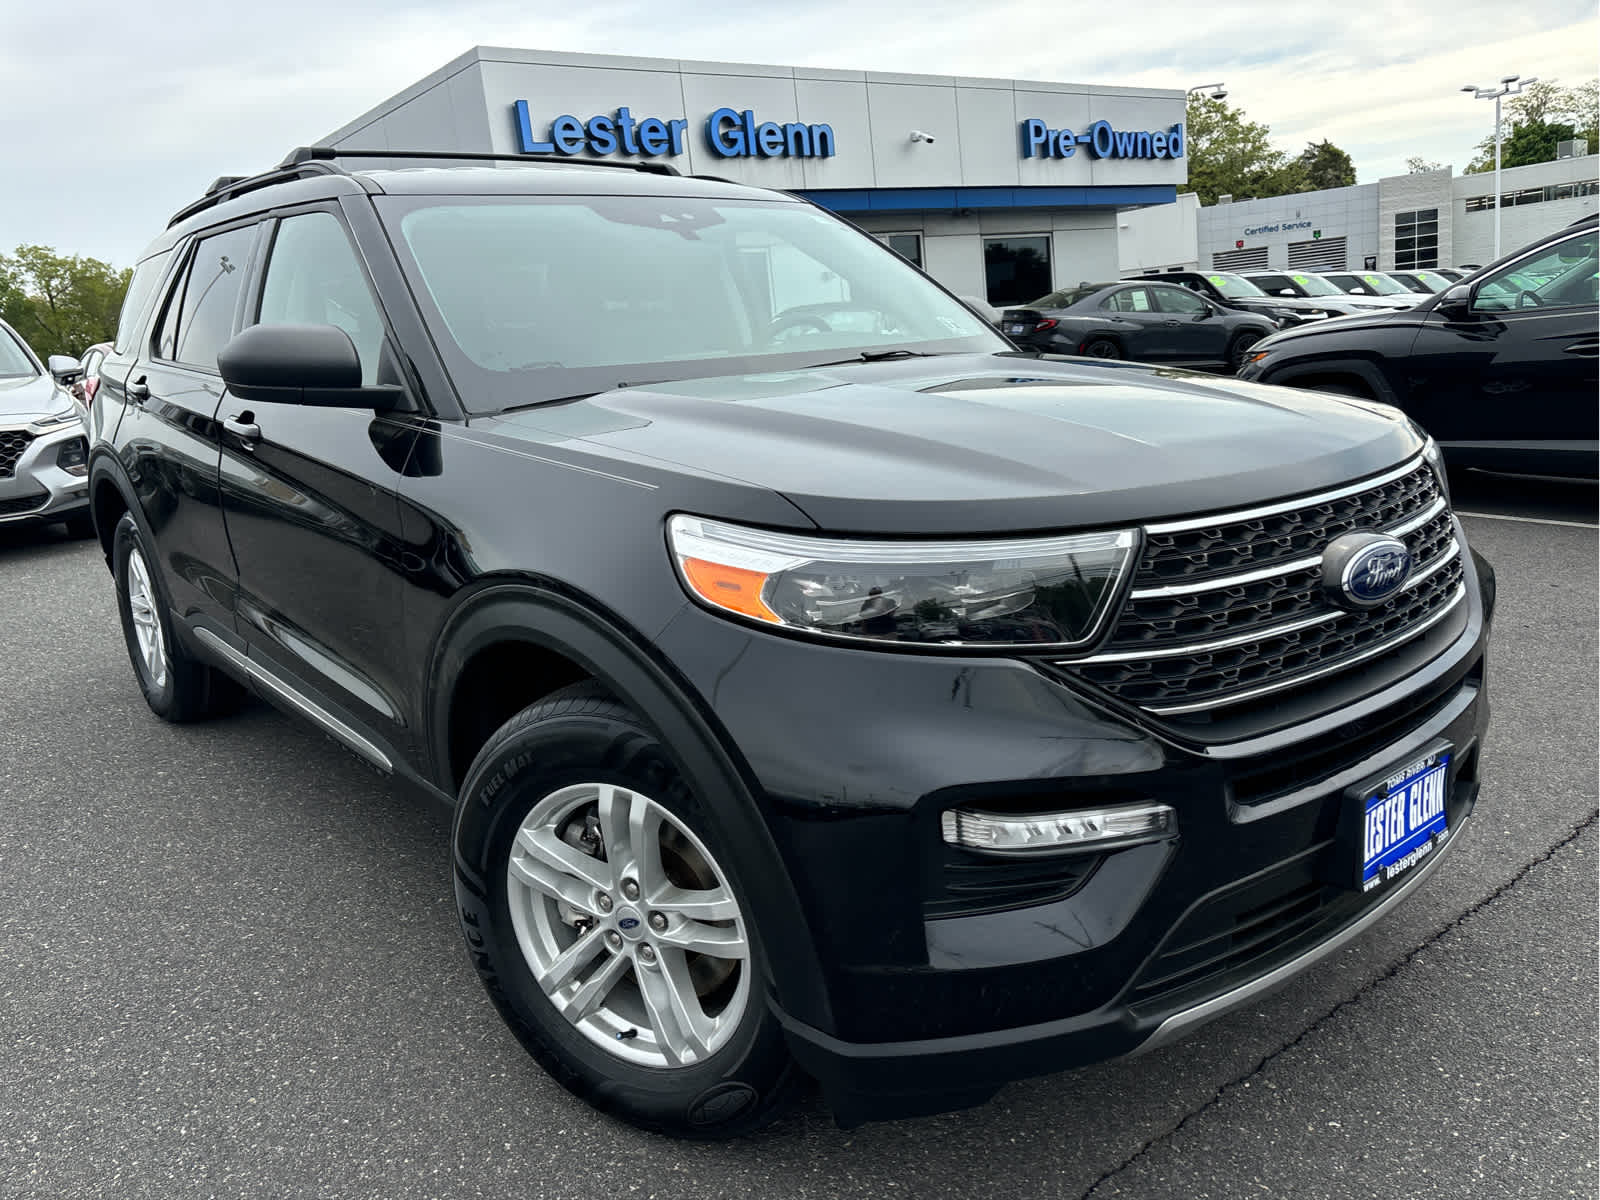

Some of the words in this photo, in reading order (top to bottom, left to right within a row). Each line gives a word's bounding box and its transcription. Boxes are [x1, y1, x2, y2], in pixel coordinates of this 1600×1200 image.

[512, 99, 688, 155] Lester
[704, 107, 836, 158] Glenn
[1023, 118, 1184, 159] Pre-Owned
[1244, 224, 1280, 236] Certified
[1282, 221, 1312, 231] Service
[1364, 791, 1407, 864] LESTER
[1409, 767, 1446, 831] GLENN
[1385, 840, 1433, 880] lesterglenn
